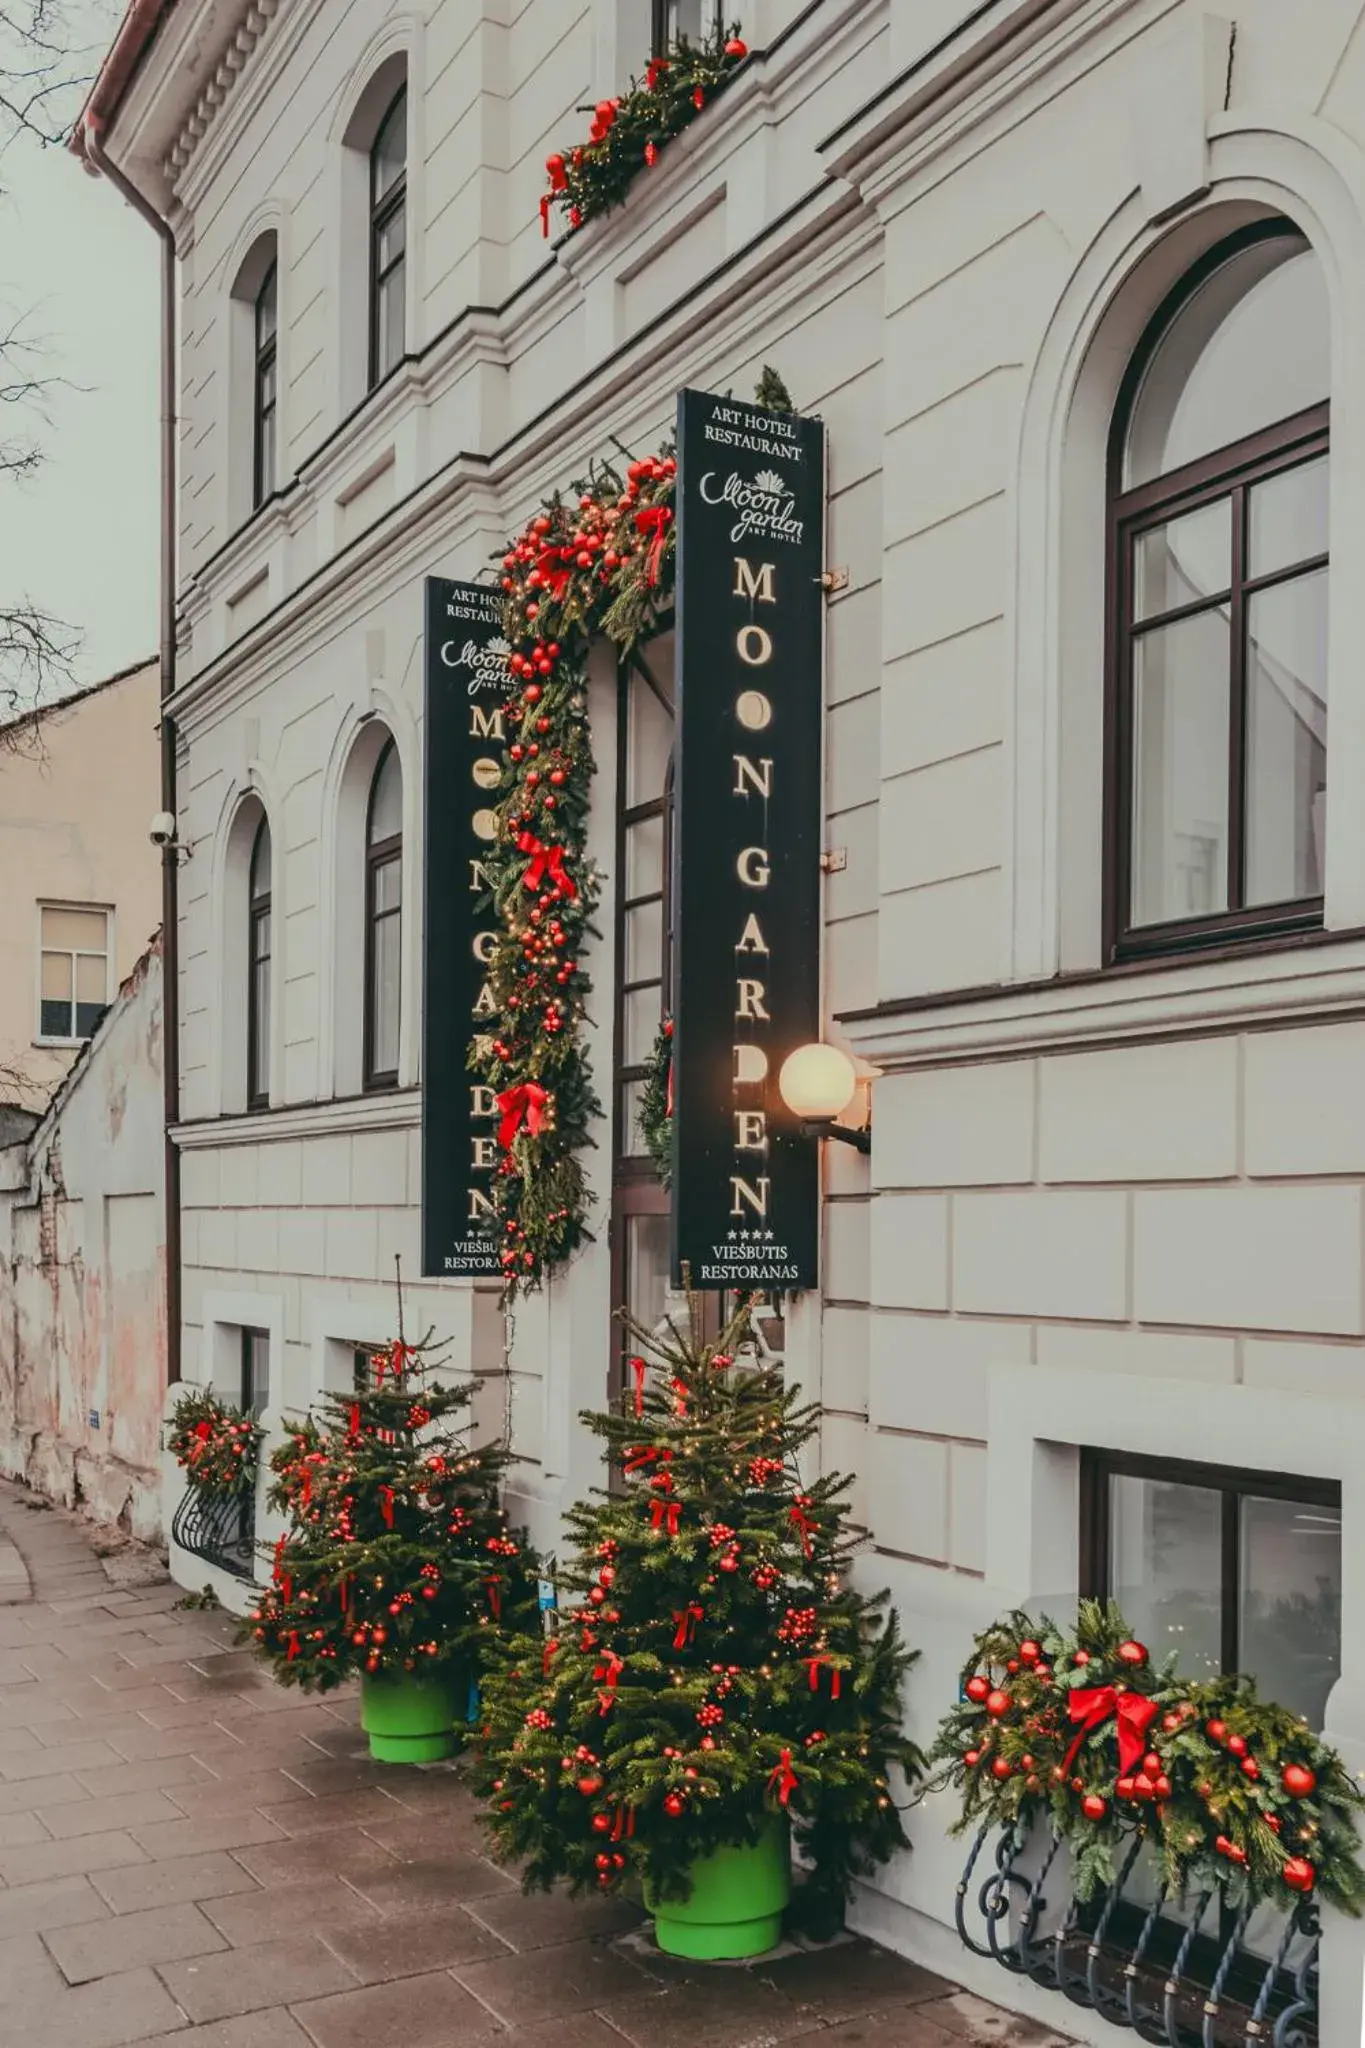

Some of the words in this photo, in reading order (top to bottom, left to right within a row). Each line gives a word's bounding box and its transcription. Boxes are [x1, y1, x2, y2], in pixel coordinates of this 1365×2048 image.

[712, 406, 742, 425] ART
[745, 413, 797, 439] HOTEL
[704, 425, 802, 461] RESTAURANT
[731, 500, 803, 542] garden
[749, 527, 767, 537] ART
[771, 532, 802, 545] HOTEL
[452, 589, 478, 603] ART
[480, 593, 505, 609] HOT
[732, 556, 777, 799] MOON
[729, 847, 771, 1217] GARDEN
[454, 1239, 498, 1253] VIEŠBU
[712, 1242, 788, 1260] VIEŠBUTIS
[444, 1257, 502, 1269] RESTORA
[701, 1264, 799, 1279] RESTORANAS
